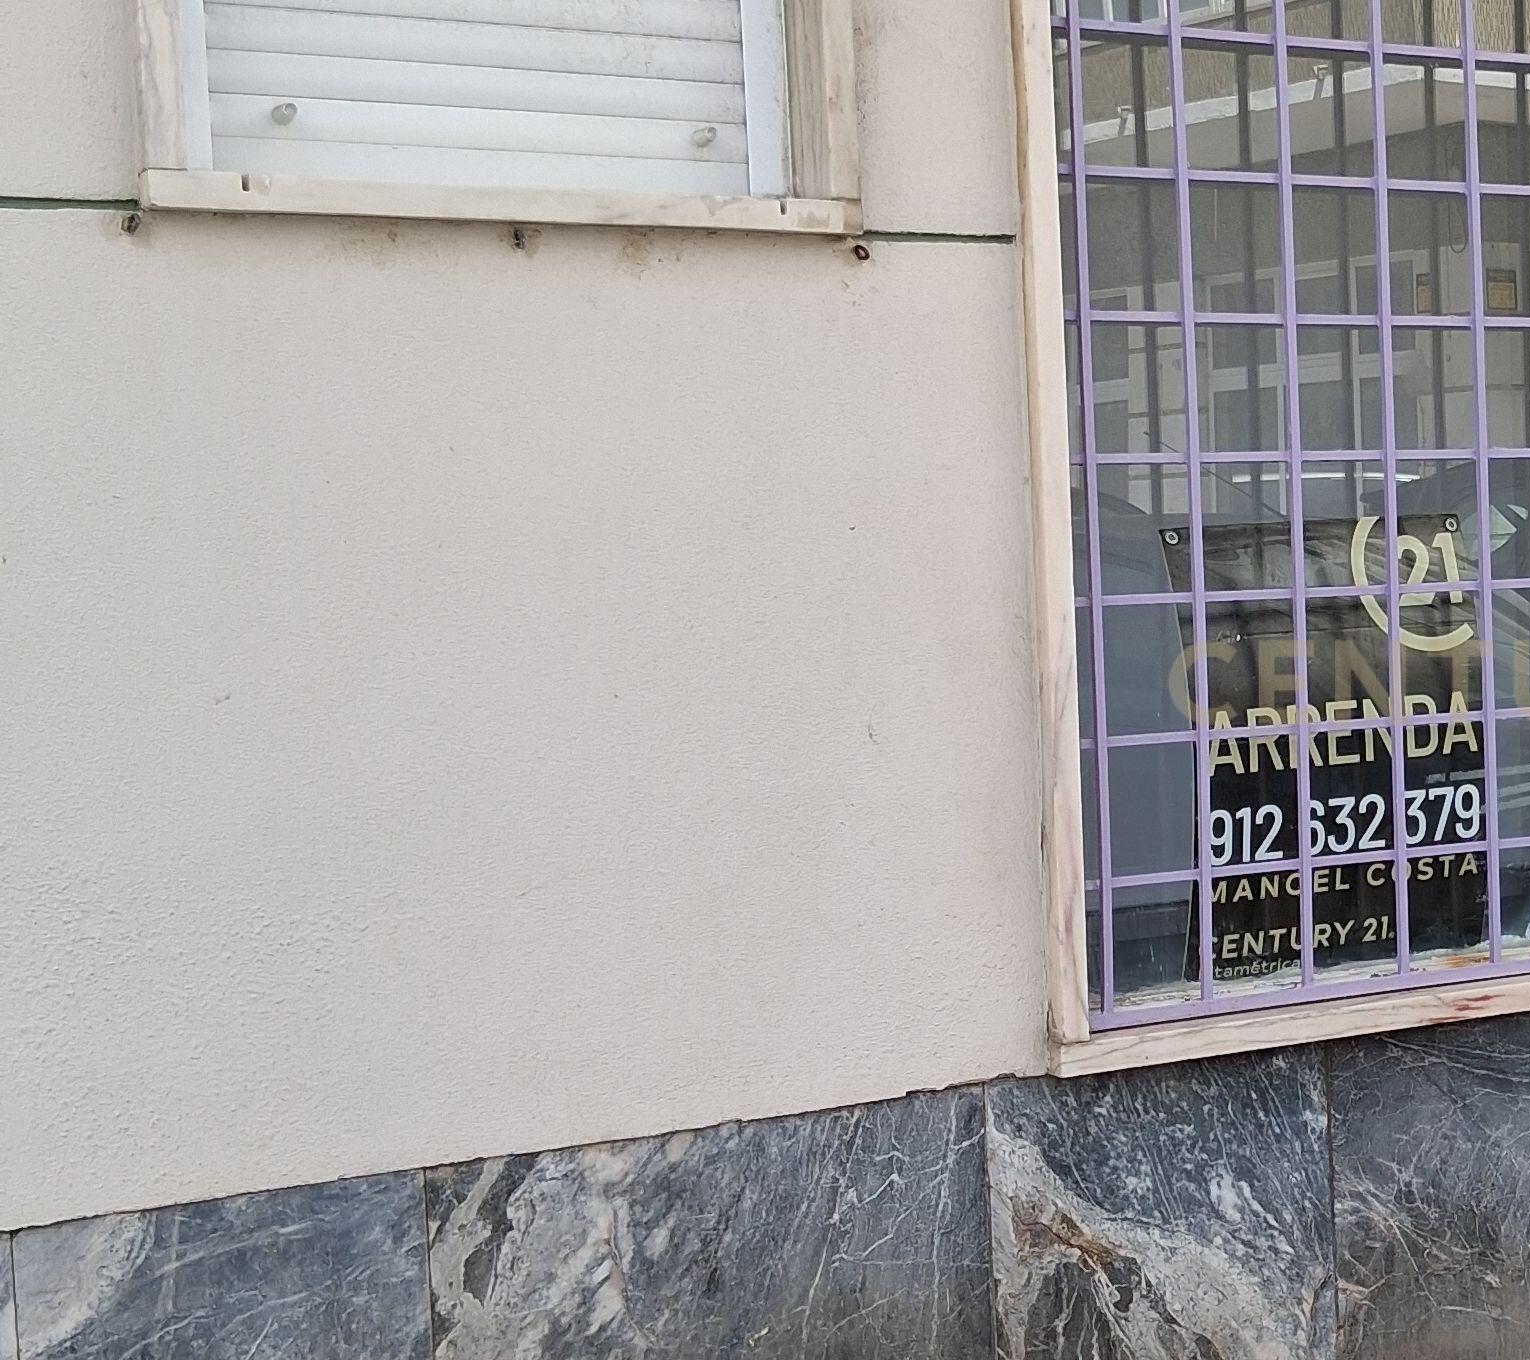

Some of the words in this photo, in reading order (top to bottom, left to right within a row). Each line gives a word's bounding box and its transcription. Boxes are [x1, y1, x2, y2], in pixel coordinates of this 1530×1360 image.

[1209, 690, 1479, 777] ARRENDA
[1210, 804, 1284, 866] 912
[1309, 793, 1386, 857] 632
[1404, 783, 1481, 845] 379
[1366, 853, 1479, 887] COSTA
